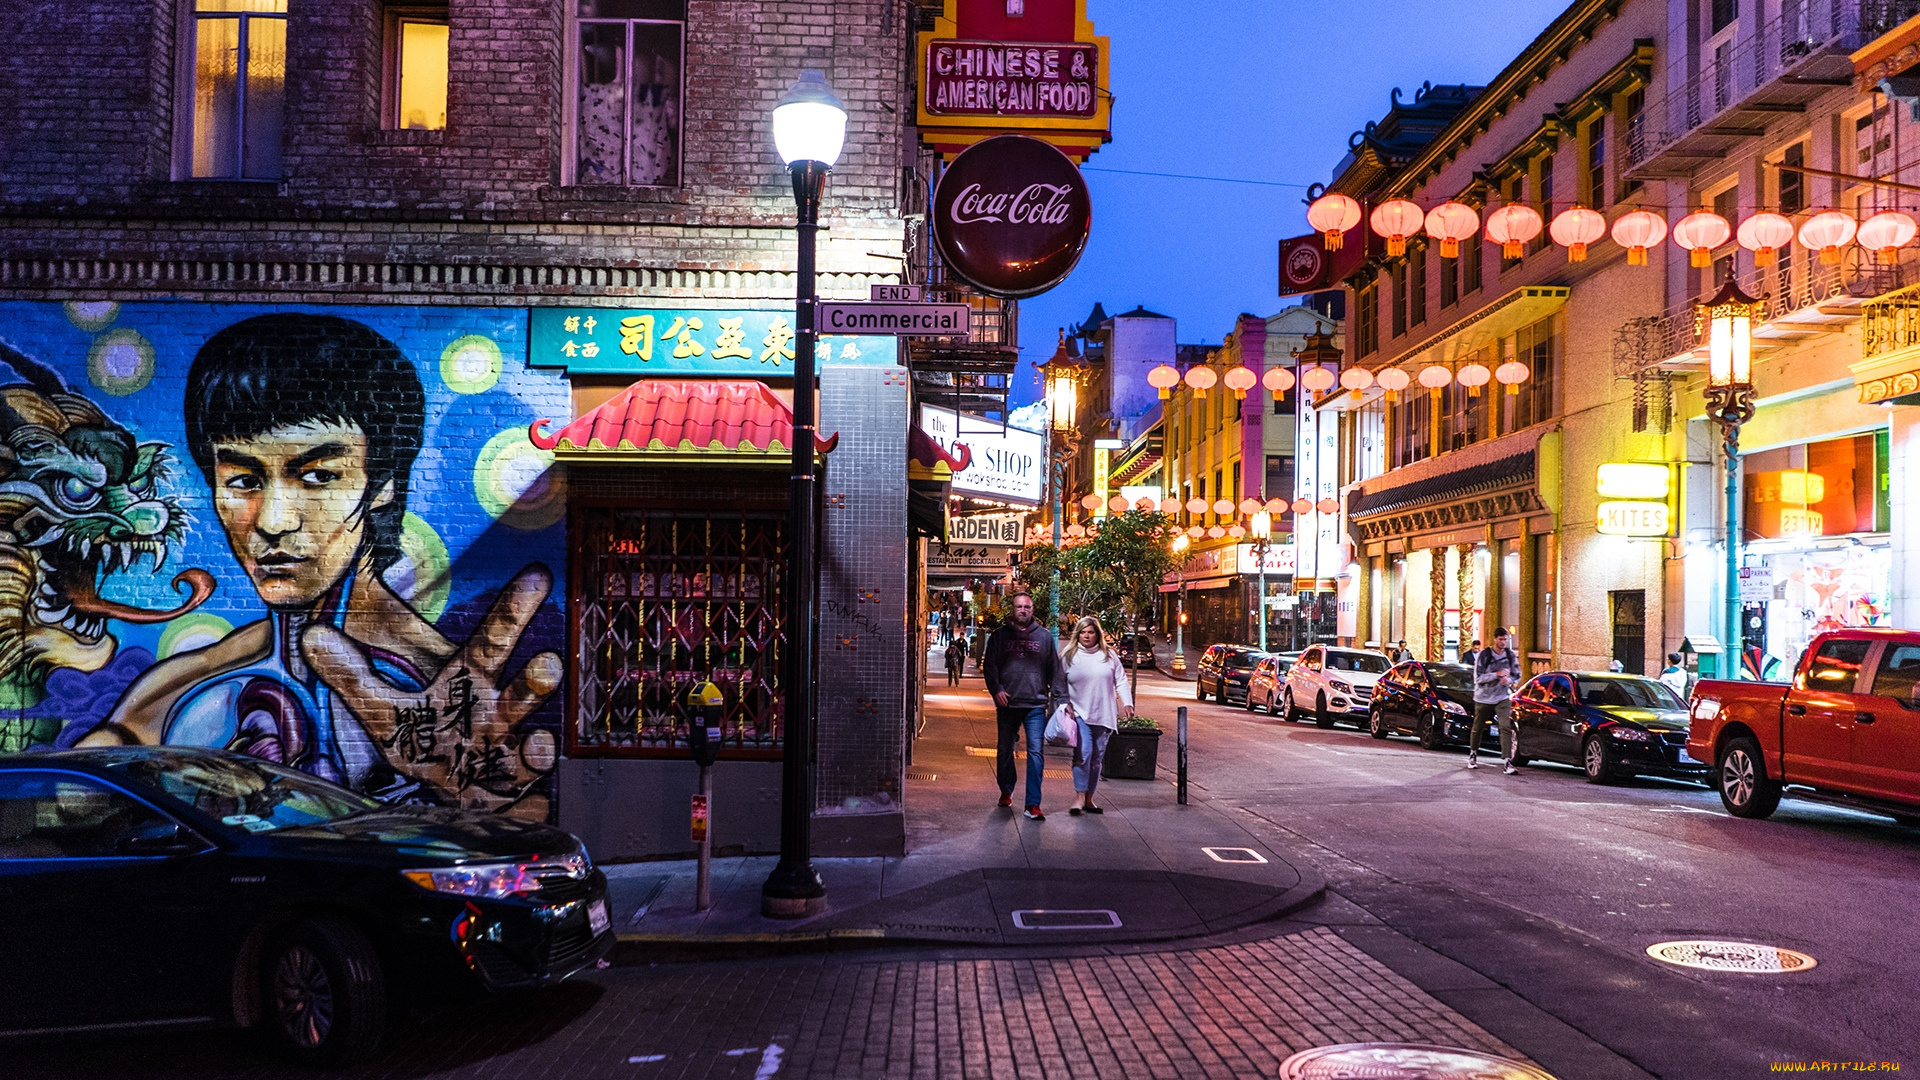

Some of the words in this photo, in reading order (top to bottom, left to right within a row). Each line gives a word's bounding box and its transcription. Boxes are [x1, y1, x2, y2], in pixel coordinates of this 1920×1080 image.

[936, 48, 1060, 78] CHINESE
[1070, 51, 1090, 79] &
[935, 79, 1033, 109] AMERICAN
[1036, 81, 1091, 111] FOOD
[950, 183, 1073, 225] Coca-Cola
[880, 287, 911, 299] END
[831, 309, 958, 329] Commercial
[932, 416, 948, 432] the
[932, 436, 976, 467] OK
[985, 446, 1032, 477] SHOP
[1608, 509, 1663, 528] KITES
[948, 519, 999, 540] ARDEN
[927, 556, 963, 565] ESTAURANT
[968, 557, 1001, 565] COCKTAILS
[1740, 568, 1750, 578] NO
